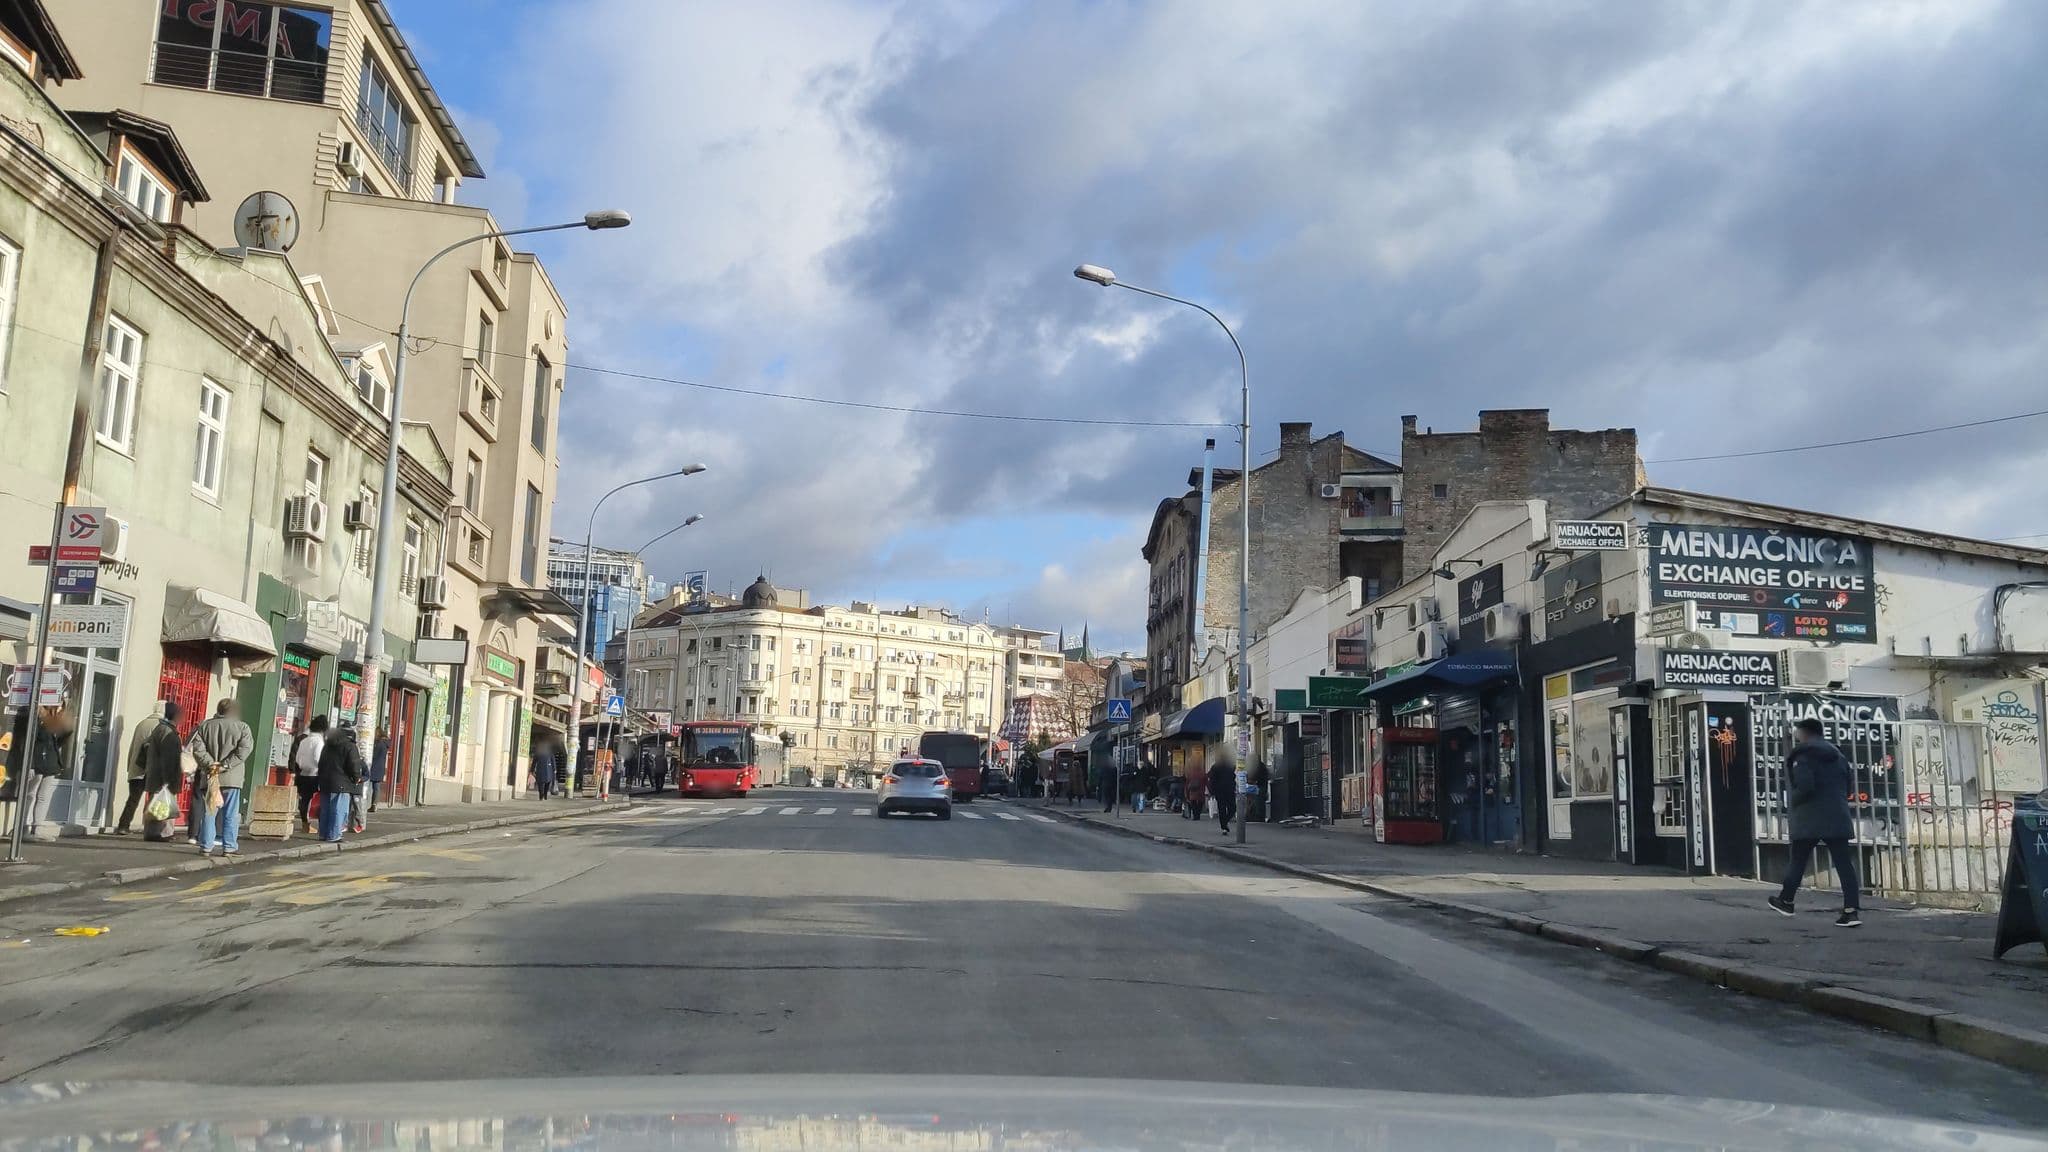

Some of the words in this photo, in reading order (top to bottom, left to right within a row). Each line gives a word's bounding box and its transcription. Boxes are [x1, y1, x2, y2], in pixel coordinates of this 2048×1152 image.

[1558, 523, 1623, 537] MENJAČNICA
[1558, 538, 1597, 547] EXCHANGE
[1598, 539, 1624, 547] OFFICE
[1660, 529, 1858, 565] MENJAČNICA
[1658, 563, 1781, 586] EXCHANGE
[1787, 570, 1865, 591] OFFICE
[1664, 590, 1717, 600] ELEKTRONSKE
[1547, 608, 1565, 623] PET
[1574, 597, 1597, 614] SHOP
[1826, 597, 1843, 611] vip
[1794, 616, 1828, 626] LOTO
[1796, 626, 1828, 636] BINGO
[1665, 653, 1773, 672] MENJAČNICA
[1665, 672, 1730, 684] EXCHANGE
[1732, 673, 1775, 685] OFFICE
[1838, 730, 1890, 742] OFFCE
